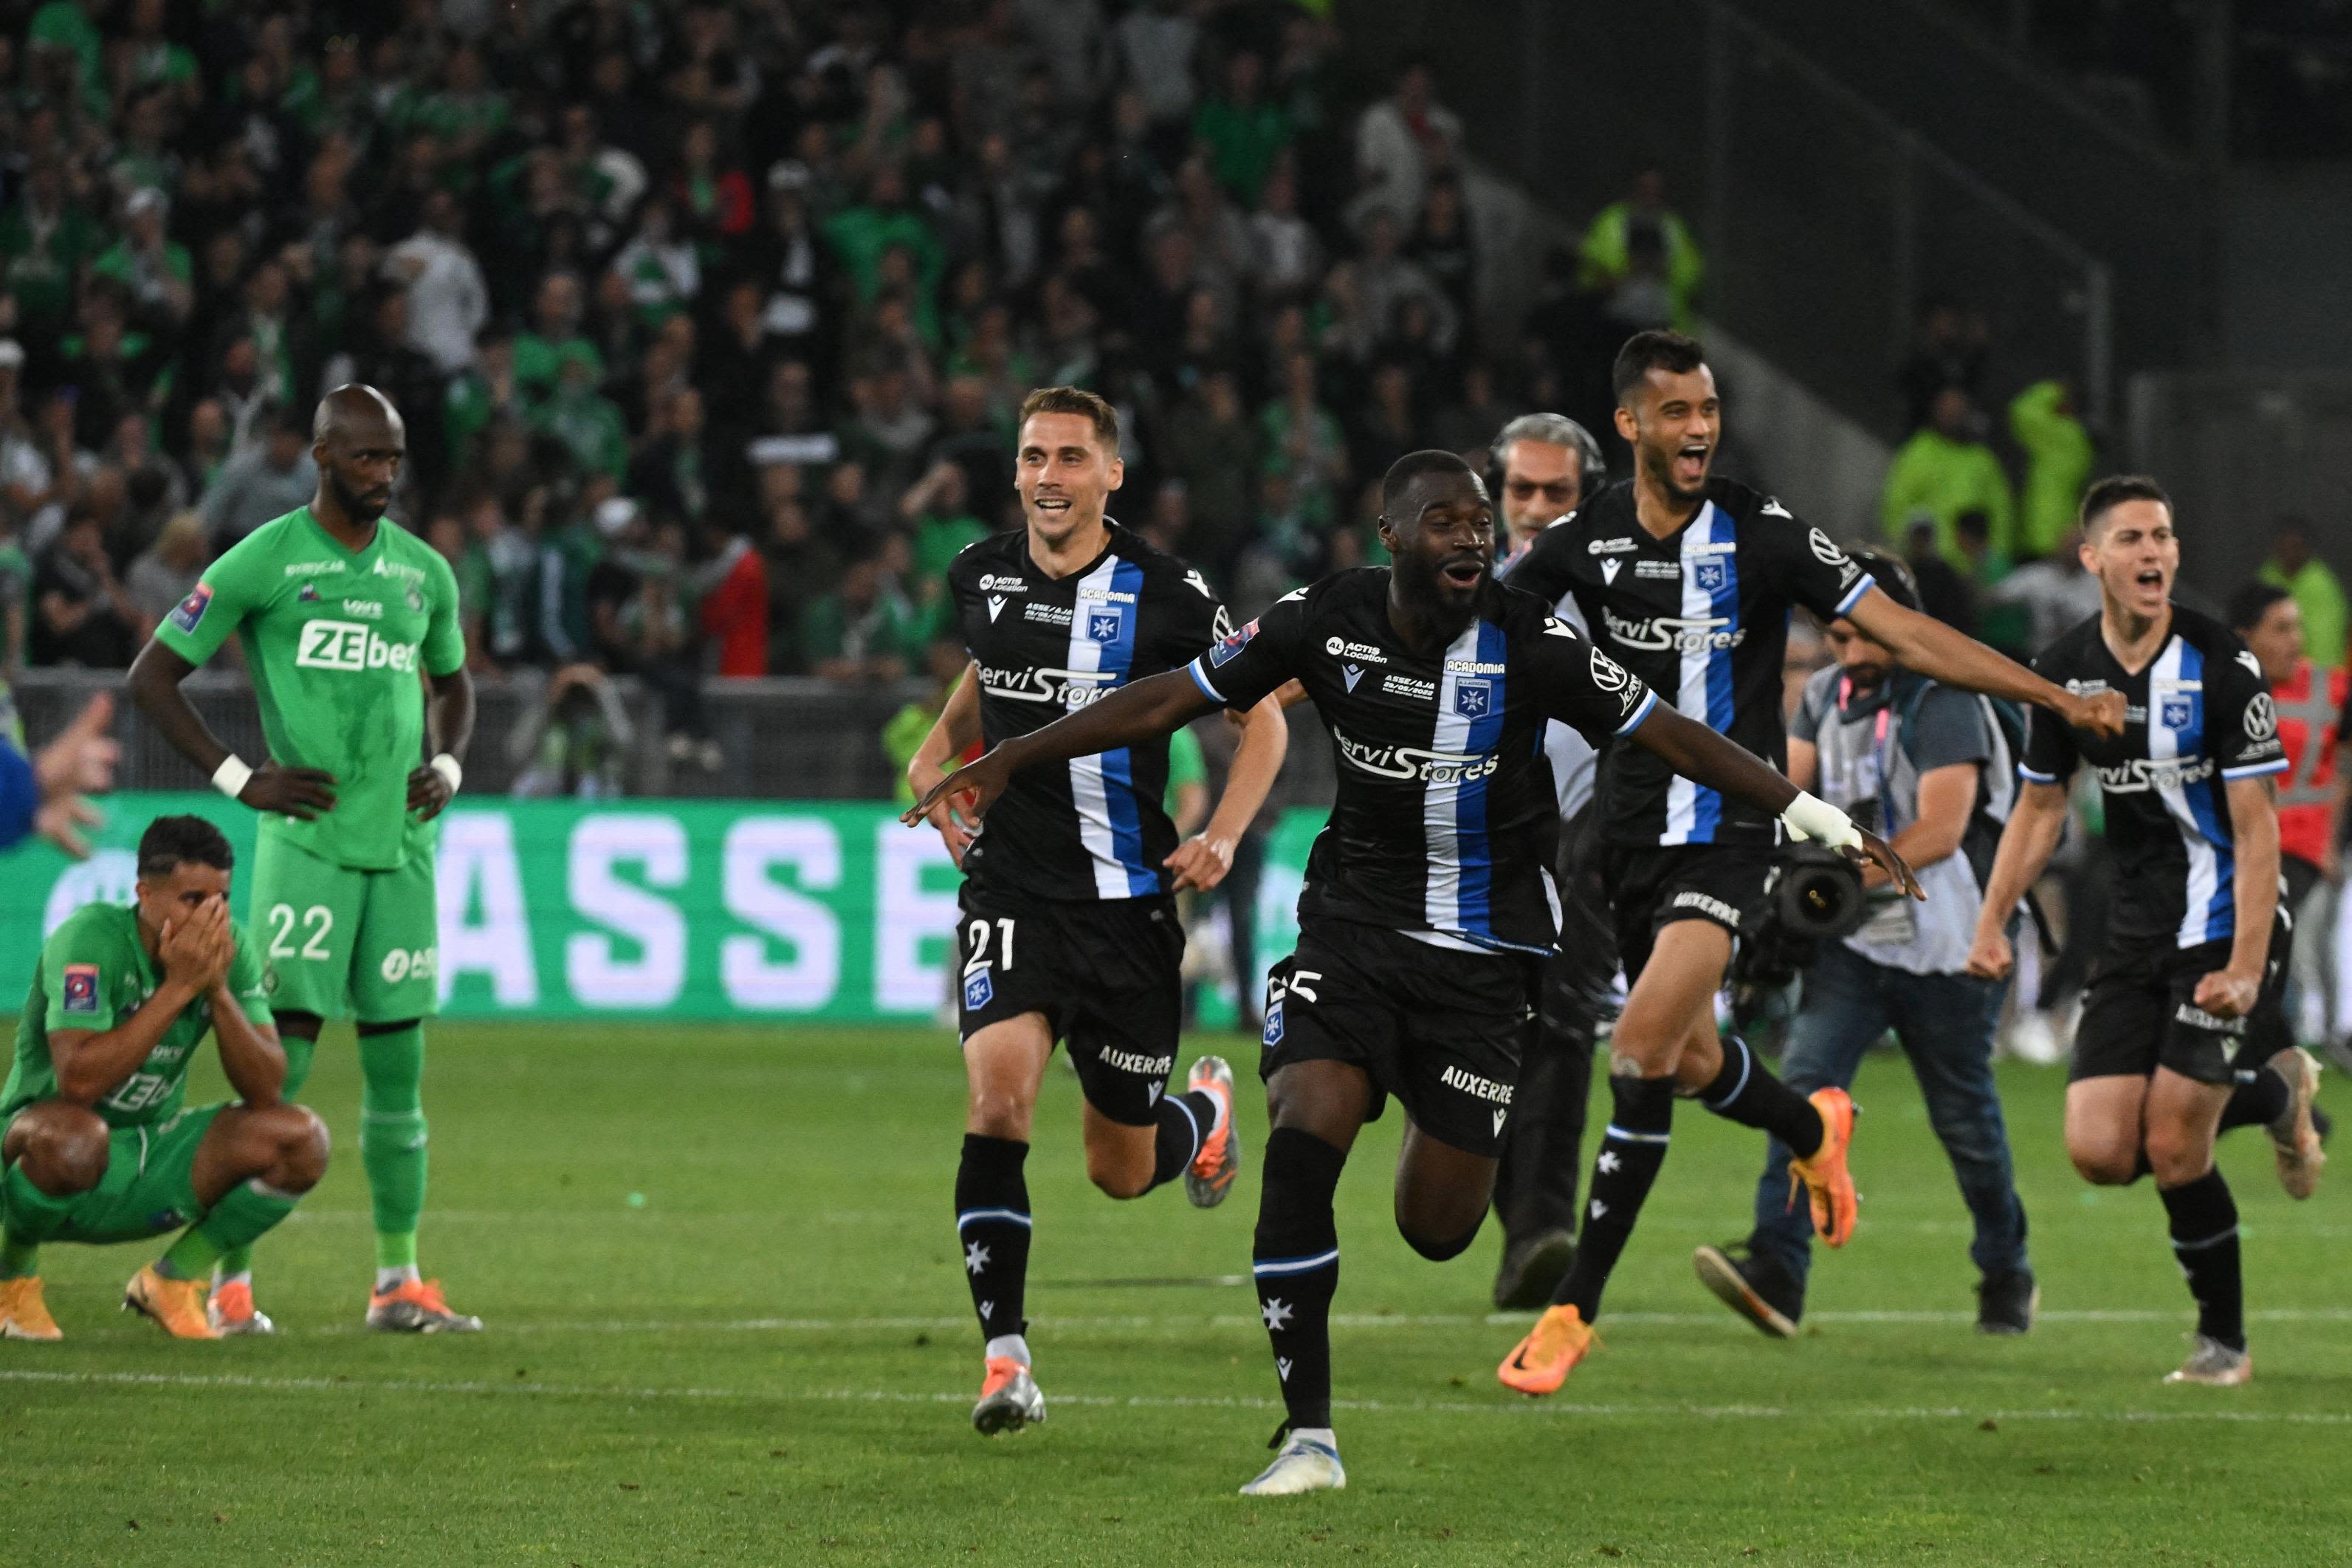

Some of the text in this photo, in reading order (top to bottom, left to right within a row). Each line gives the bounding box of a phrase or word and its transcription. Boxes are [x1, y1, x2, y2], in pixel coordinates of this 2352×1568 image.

[1079, 588, 1135, 604] ACADOMIA
[302, 623, 419, 673] ZEbet
[1344, 648, 1388, 664] Location
[1345, 642, 1380, 655] ACTIS
[1447, 660, 1505, 674] ACADOMIA
[1385, 675, 1435, 690] ASSE/AJA
[436, 813, 962, 1012] ASSE
[269, 903, 333, 960] 22
[963, 917, 1015, 977] 21
[1098, 1045, 1172, 1074] AUXERRE
[1441, 1065, 1514, 1104] AUXERRE
